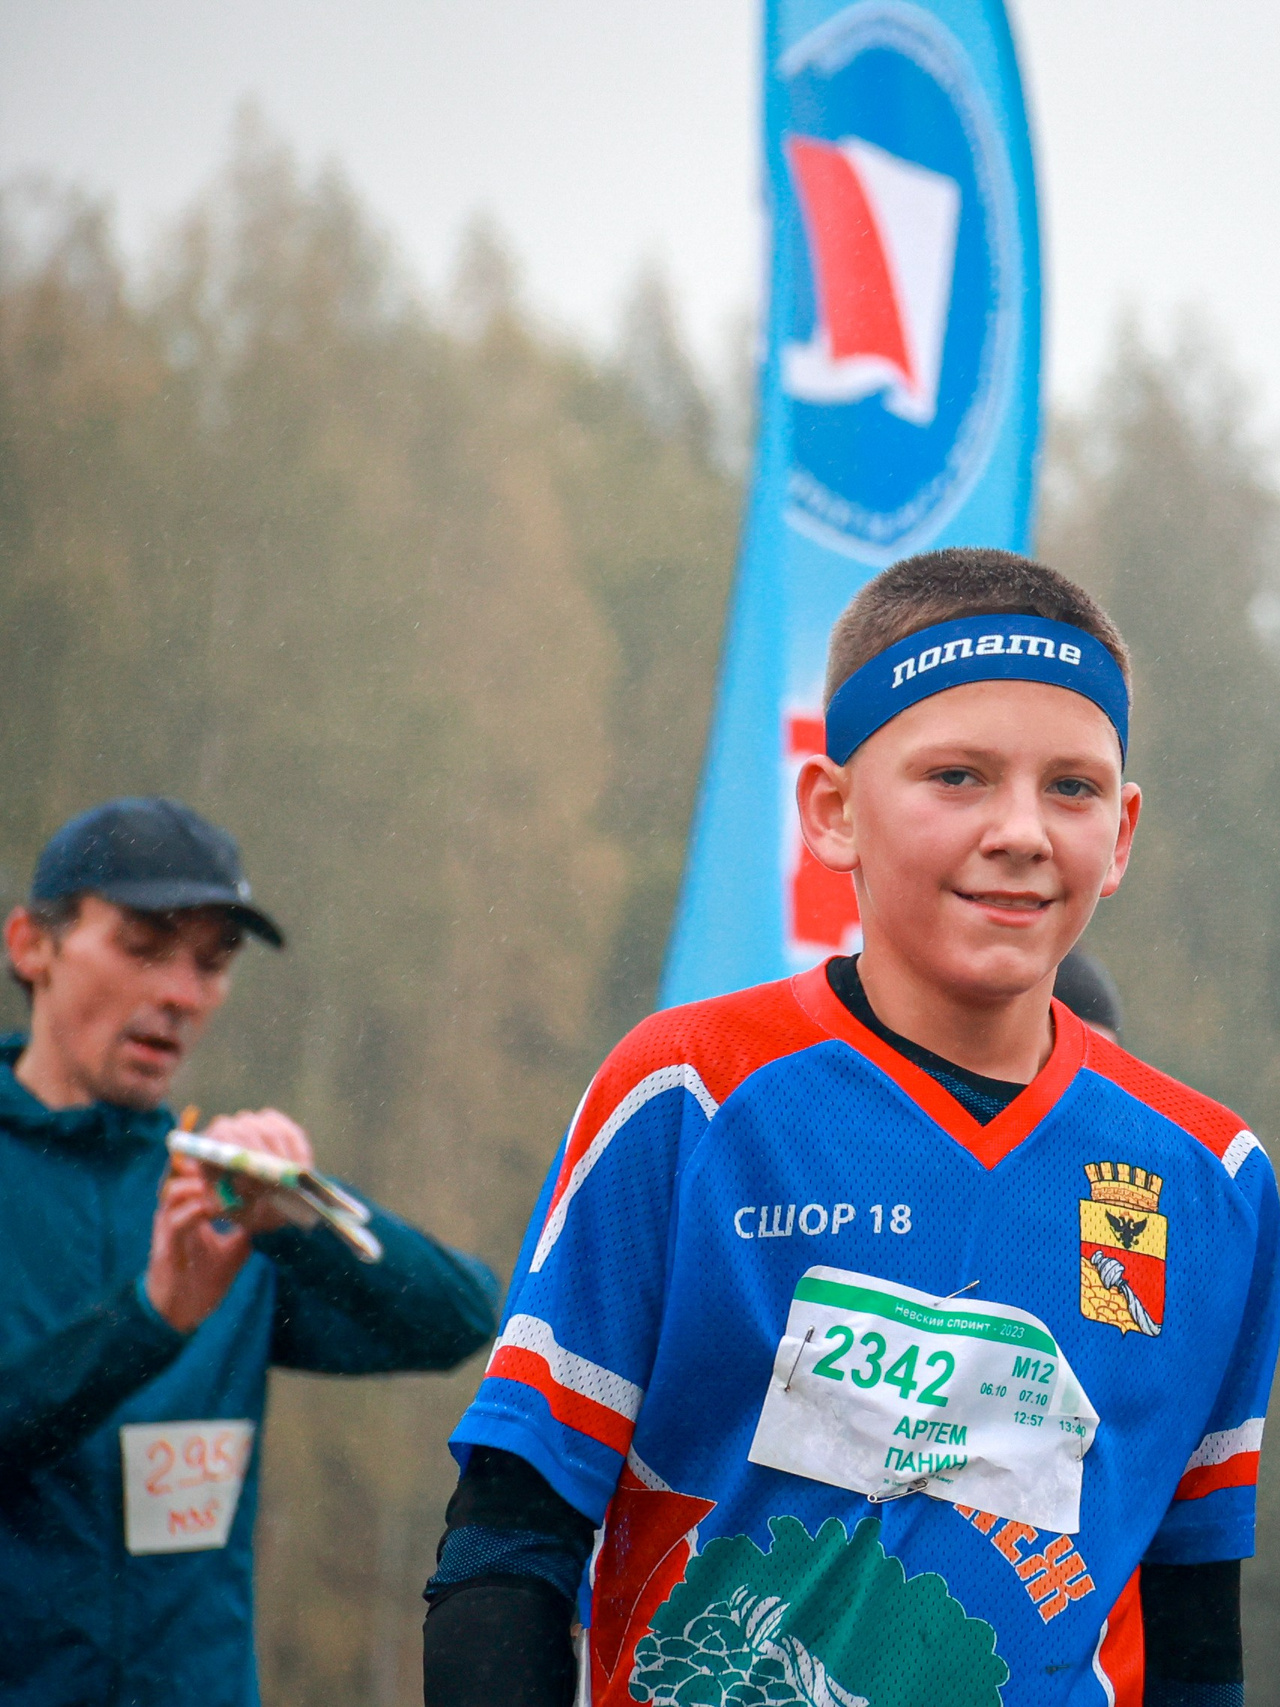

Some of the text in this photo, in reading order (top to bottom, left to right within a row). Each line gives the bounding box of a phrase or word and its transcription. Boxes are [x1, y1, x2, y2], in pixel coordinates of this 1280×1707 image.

[891, 634, 1082, 689] noname
[734, 1203, 912, 1239] СШОР 18
[947, 1317, 990, 1332] спринт
[1000, 1323, 1025, 1339] 2023
[812, 1325, 955, 1408] 2342
[980, 1382, 1048, 1406] 06.10 07.10
[893, 1415, 968, 1446] АРТЕМ
[1014, 1411, 1044, 1427] 12:57
[884, 1446, 968, 1474] ПАНИН
